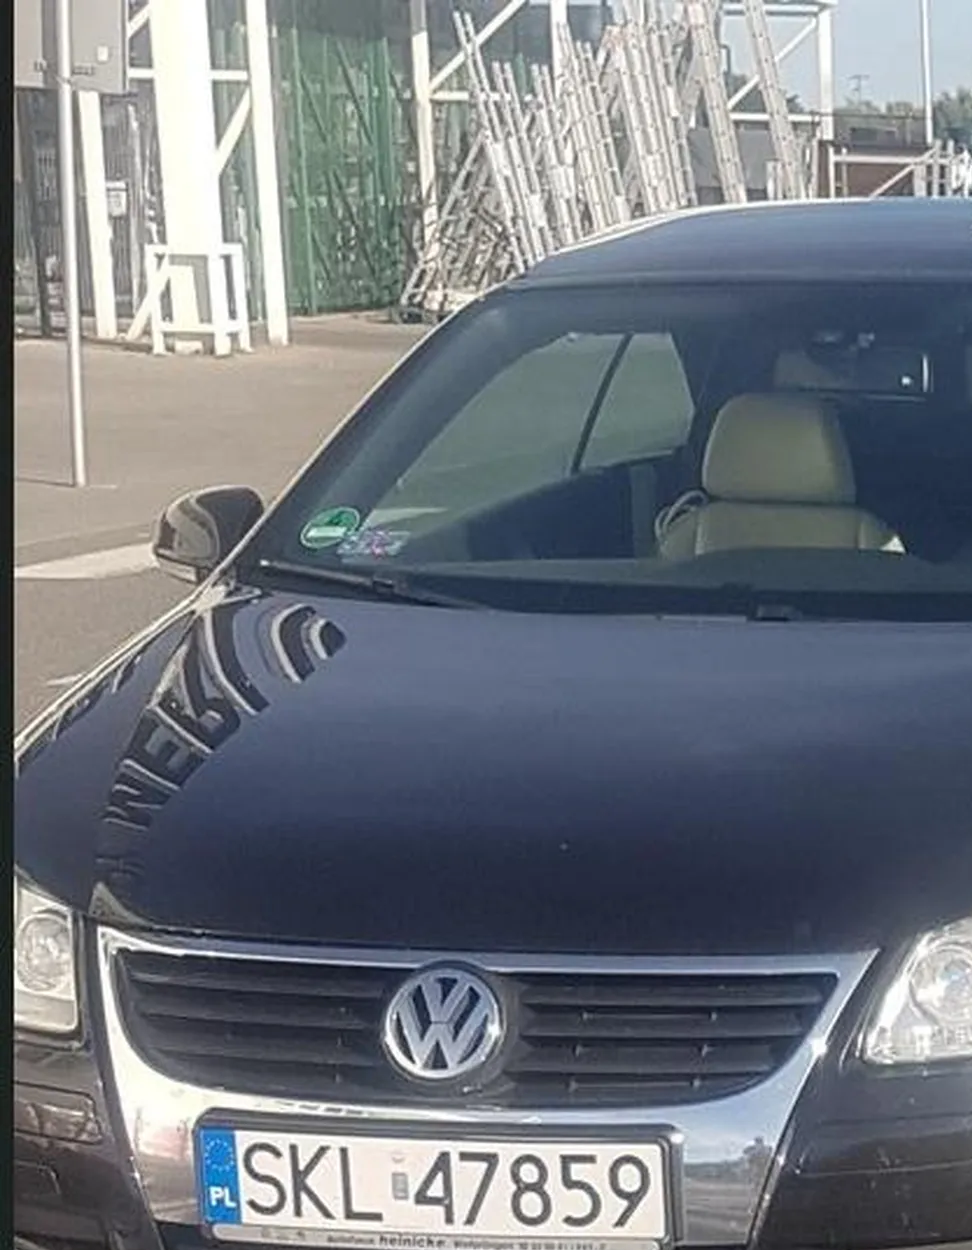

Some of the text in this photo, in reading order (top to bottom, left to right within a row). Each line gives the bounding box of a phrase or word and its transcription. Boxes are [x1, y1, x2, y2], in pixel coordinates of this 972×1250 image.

[209, 1186, 237, 1209] PL
[243, 1141, 651, 1229] SKL 47859
